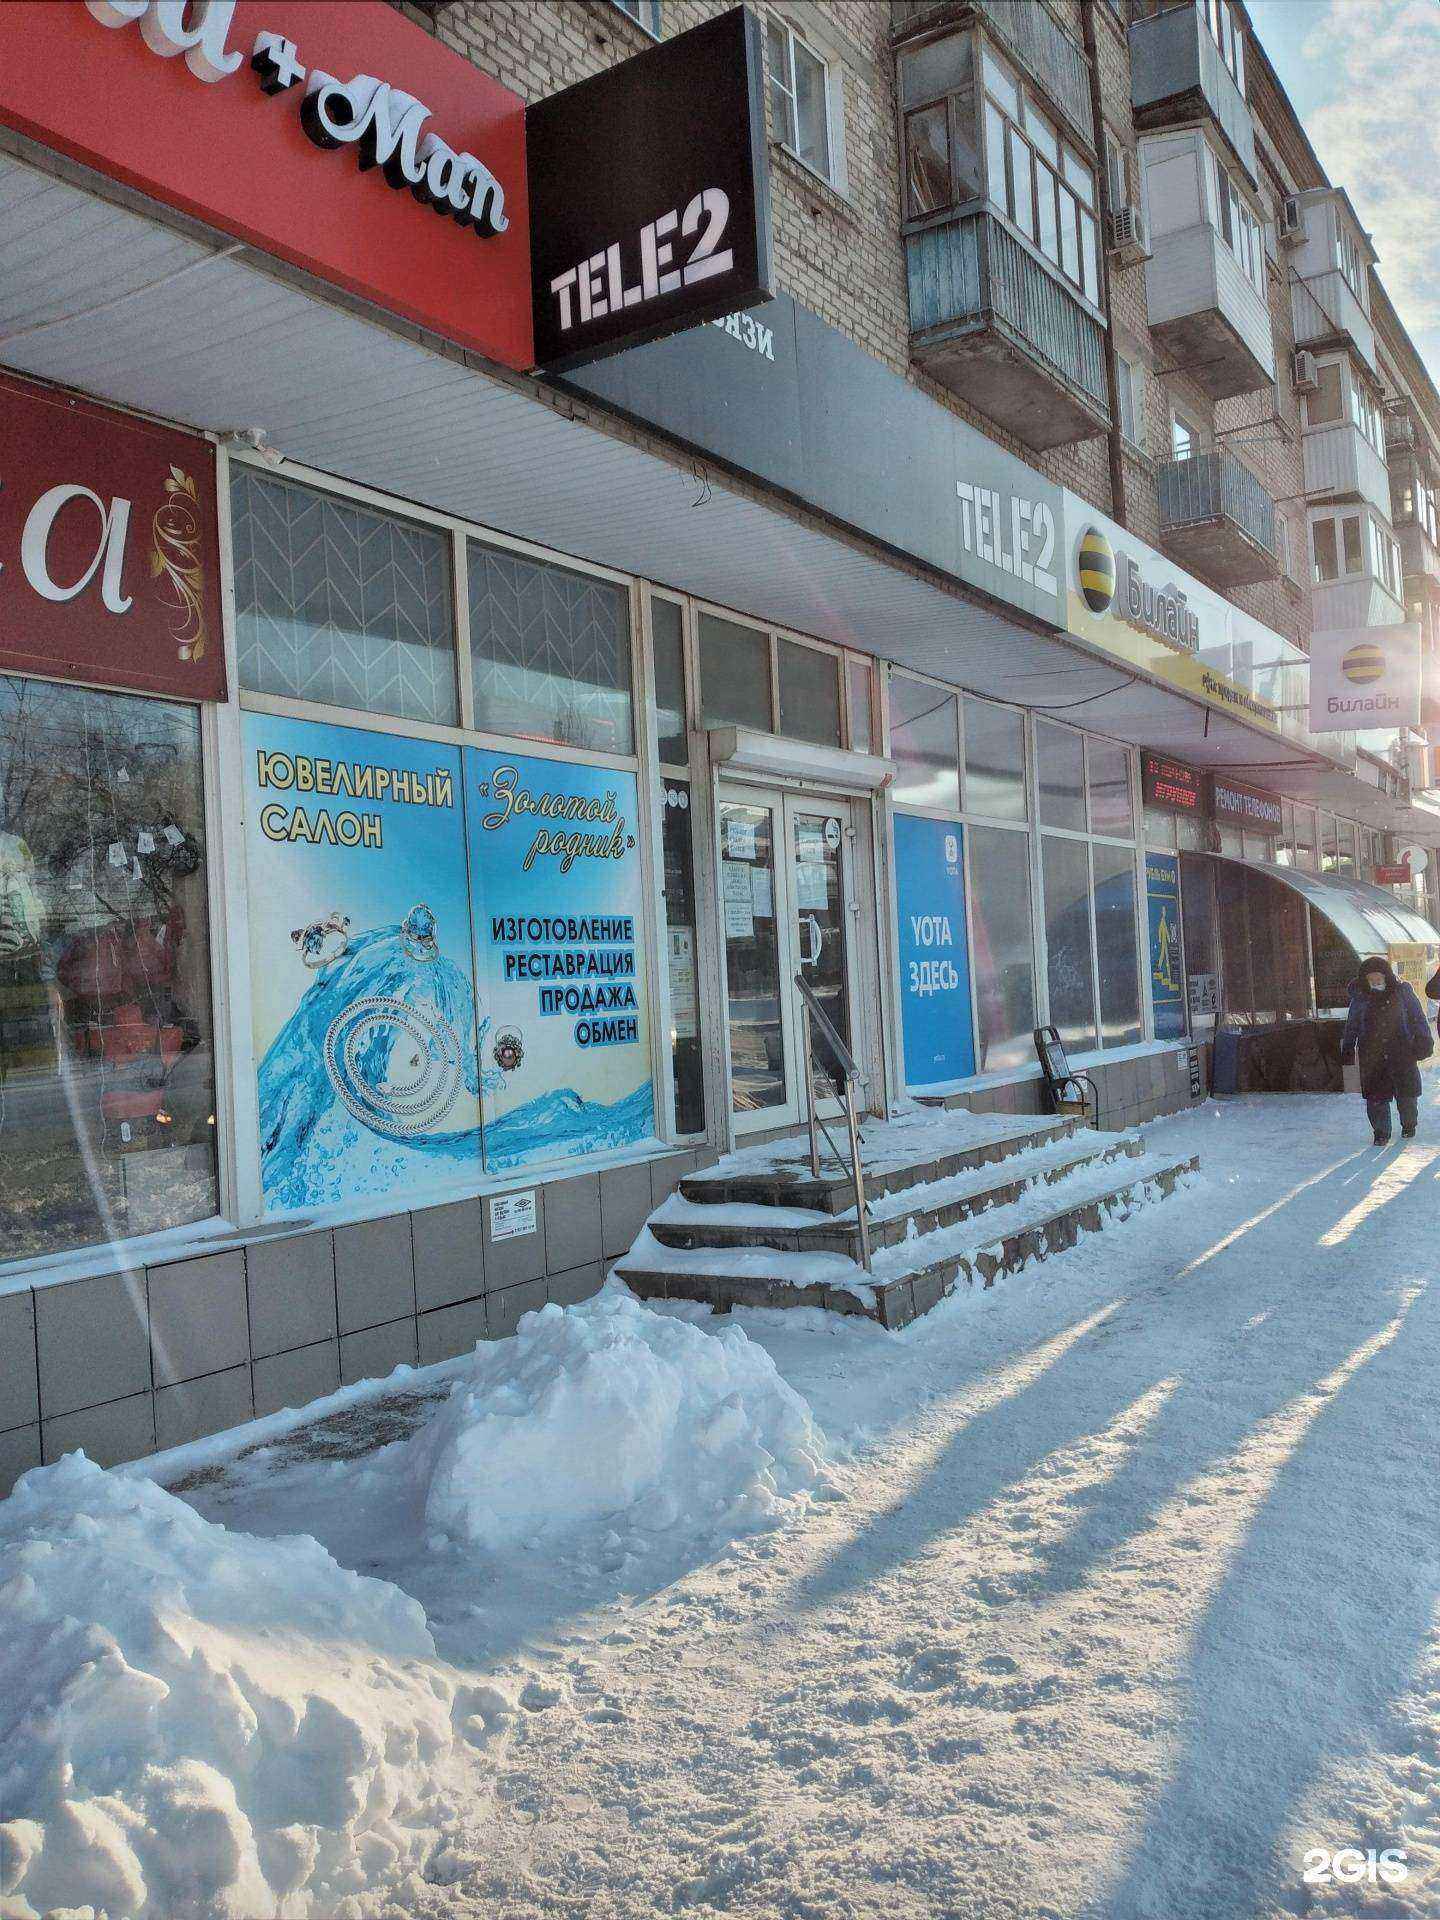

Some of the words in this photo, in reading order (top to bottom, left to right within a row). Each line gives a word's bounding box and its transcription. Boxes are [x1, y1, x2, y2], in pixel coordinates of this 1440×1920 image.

[550, 186, 734, 332] TELE2
[955, 479, 1058, 598] TELE2
[1124, 553, 1200, 656] Билайн
[1327, 692, 1400, 715] Билайн
[256, 749, 454, 808] ЮВЕЛИРНЫЙ
[260, 803, 384, 848] САЛОН
[492, 916, 634, 942] ИЗГОТОВЛЕНИЕ
[910, 915, 953, 946] YOTA
[505, 951, 634, 978] РЕСТАВРАЦИЯ
[909, 960, 959, 996] ЗДЕСЬ
[540, 985, 637, 1013] ПРОДАЖА
[576, 1018, 638, 1045] ОБМЕН
